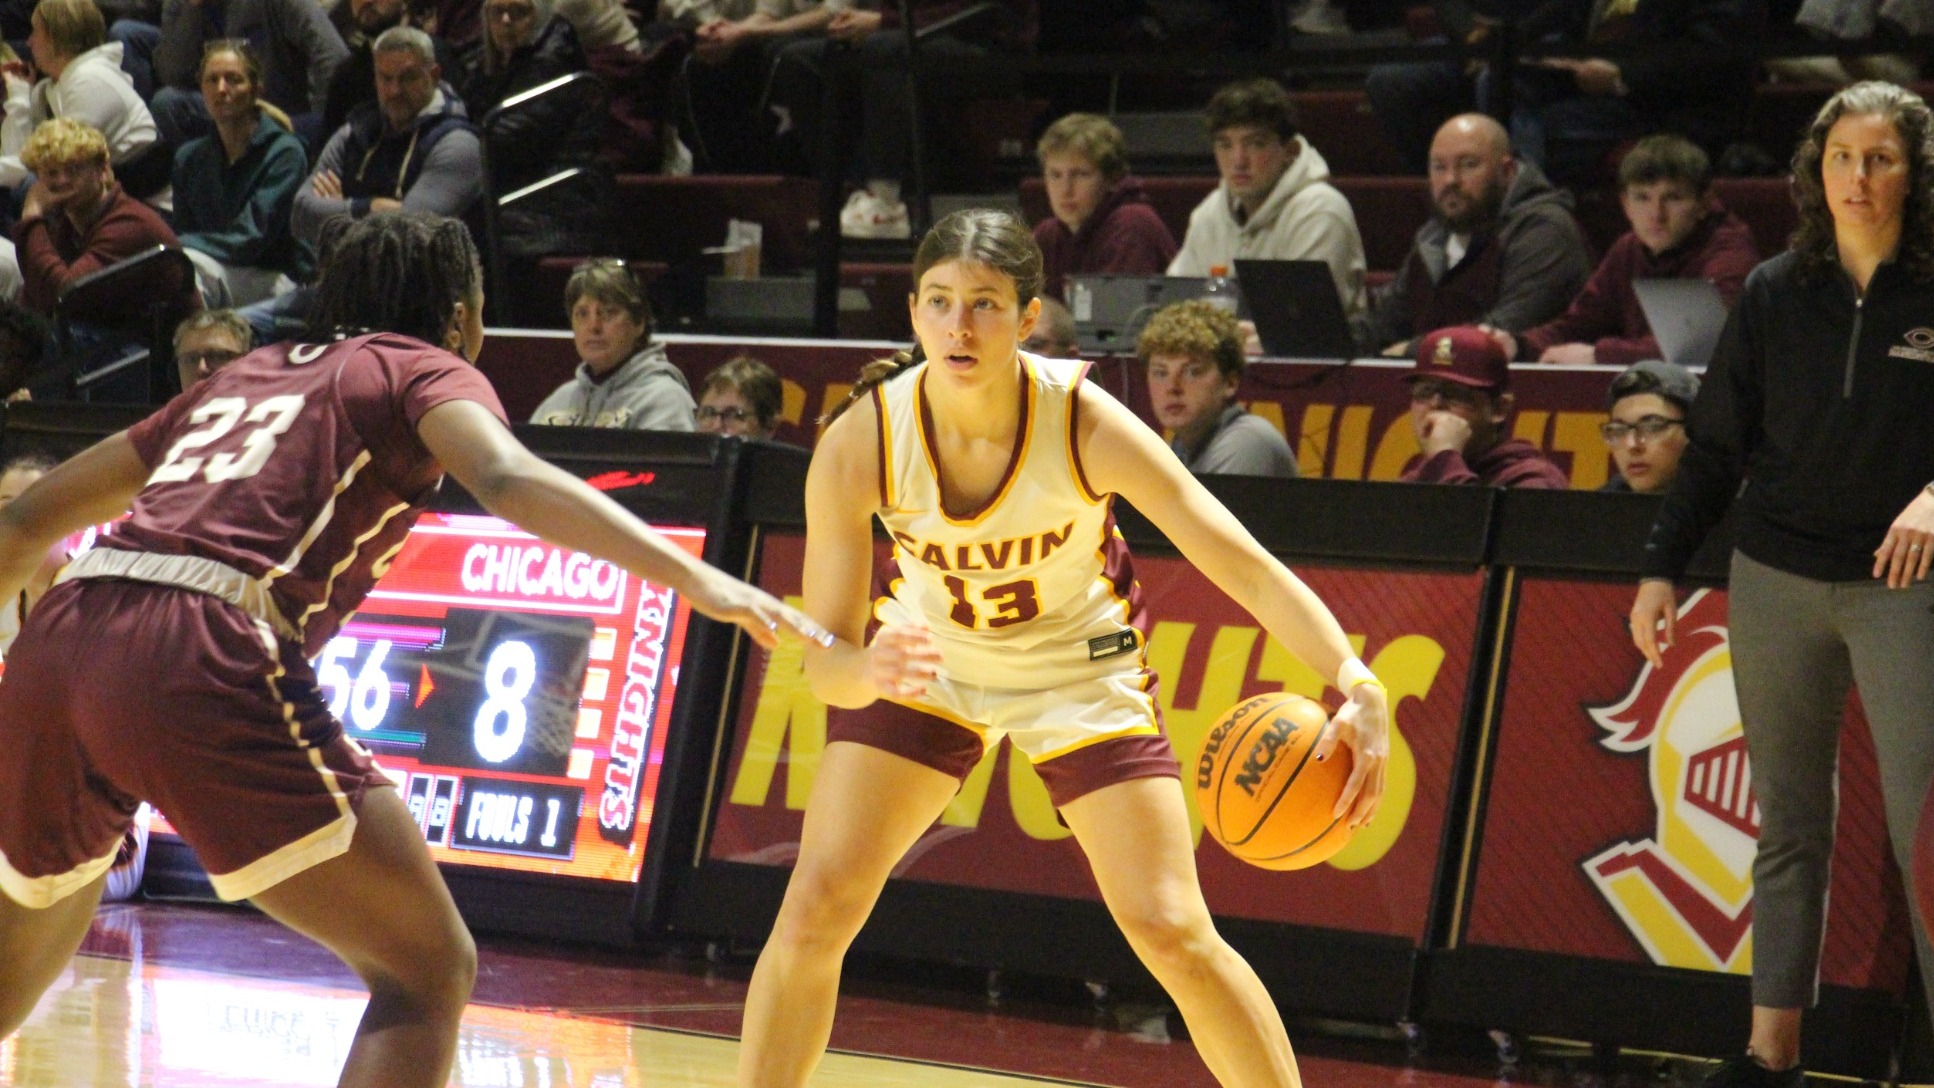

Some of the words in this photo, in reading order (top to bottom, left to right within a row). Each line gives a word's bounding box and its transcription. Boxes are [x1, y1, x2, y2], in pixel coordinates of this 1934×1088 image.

[145, 394, 306, 486] 23
[461, 543, 619, 600] CHICAGO
[943, 574, 1041, 628] 13
[1123, 636, 1133, 646] M
[473, 640, 536, 763] 8
[598, 577, 674, 832] KNIGHTS
[1235, 717, 1299, 797] NCAA
[465, 791, 534, 844] FOULS
[540, 798, 560, 847] 1
